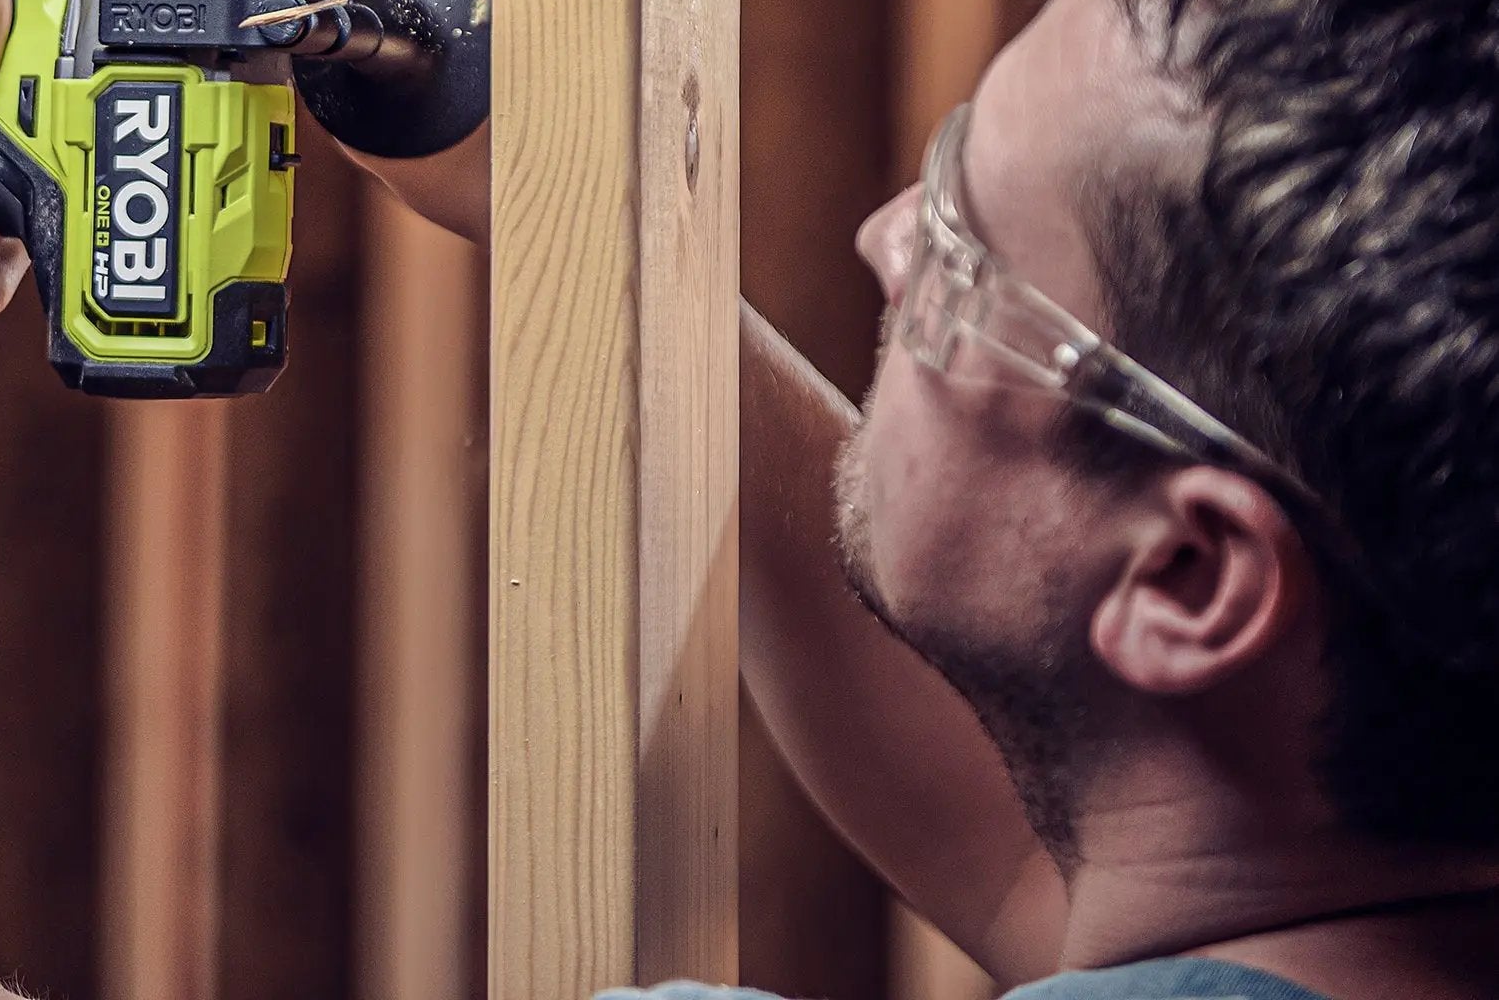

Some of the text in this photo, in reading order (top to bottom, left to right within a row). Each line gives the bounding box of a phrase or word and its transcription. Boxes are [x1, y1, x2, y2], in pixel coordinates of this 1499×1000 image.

[111, 3, 207, 33] RYOBI
[113, 95, 171, 300] RYOBI
[95, 251, 109, 299] HP
